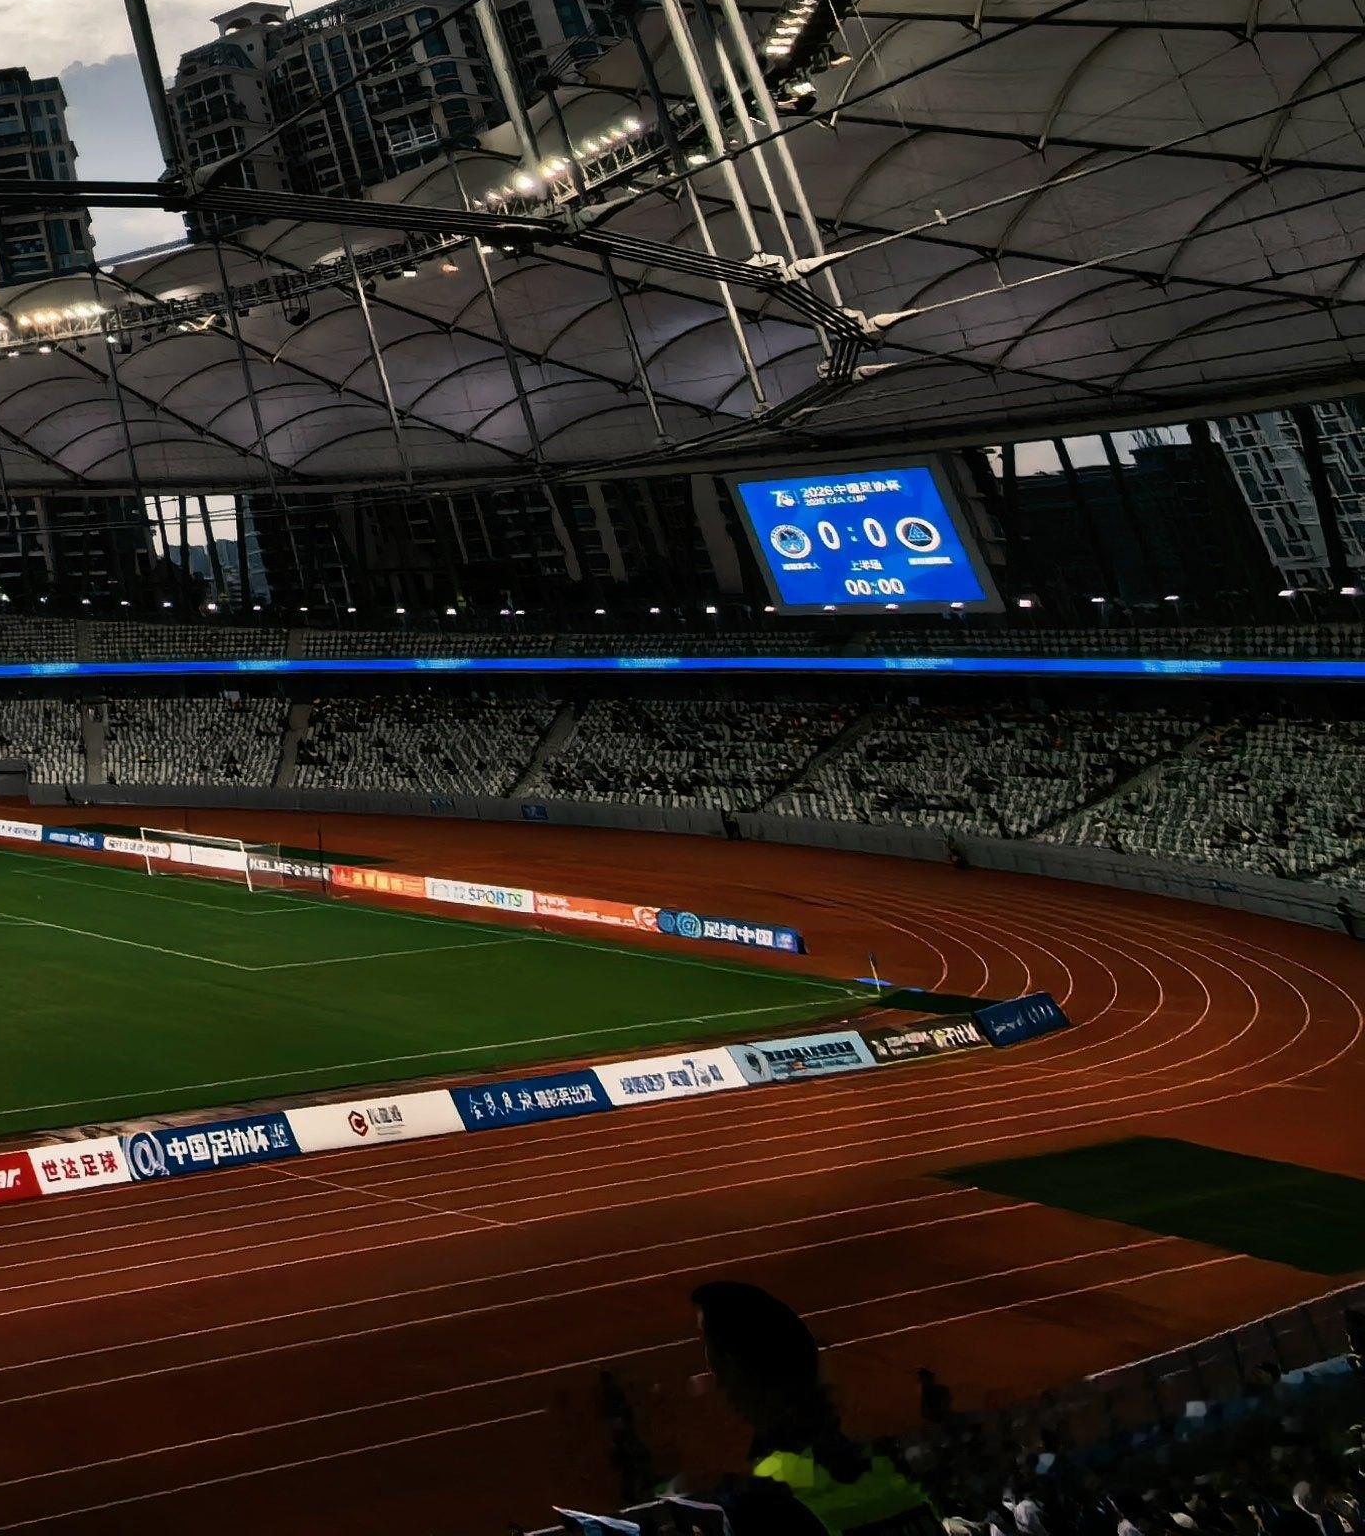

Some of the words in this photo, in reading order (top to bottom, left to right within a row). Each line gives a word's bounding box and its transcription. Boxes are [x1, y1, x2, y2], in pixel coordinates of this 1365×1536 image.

[817, 520, 841, 550] 0
[863, 517, 887, 547] 0
[844, 577, 906, 595] 00:00
[166, 1125, 270, 1165] 中国足协杯
[41, 1150, 119, 1183] 世达足球
